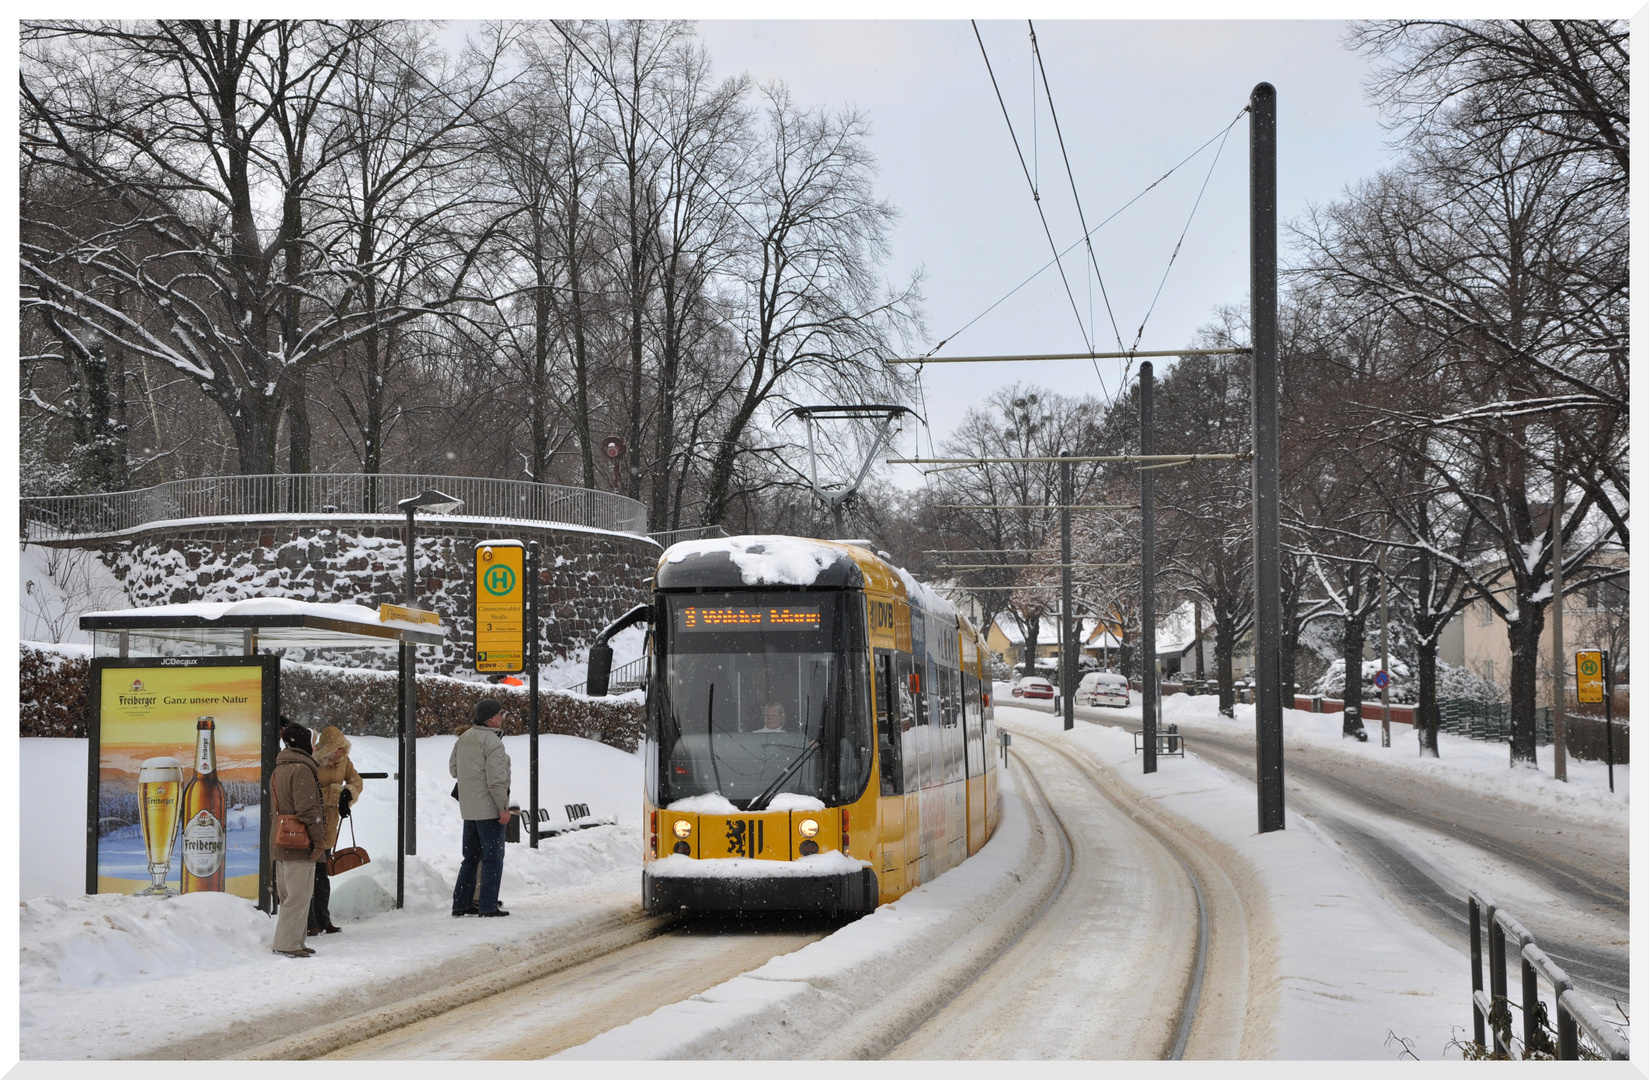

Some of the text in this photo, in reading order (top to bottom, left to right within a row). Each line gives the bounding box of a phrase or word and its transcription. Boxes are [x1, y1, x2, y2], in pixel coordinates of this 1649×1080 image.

[492, 571, 507, 589] H
[878, 601, 894, 629] DVB
[486, 623, 493, 631] 3
[161, 658, 198, 666] JCDecaux
[119, 695, 157, 707] Freiberger
[163, 696, 187, 705] Ganz
[222, 695, 248, 703] Natur
[147, 797, 175, 805] Freiberger
[185, 839, 223, 853] Freiberger
